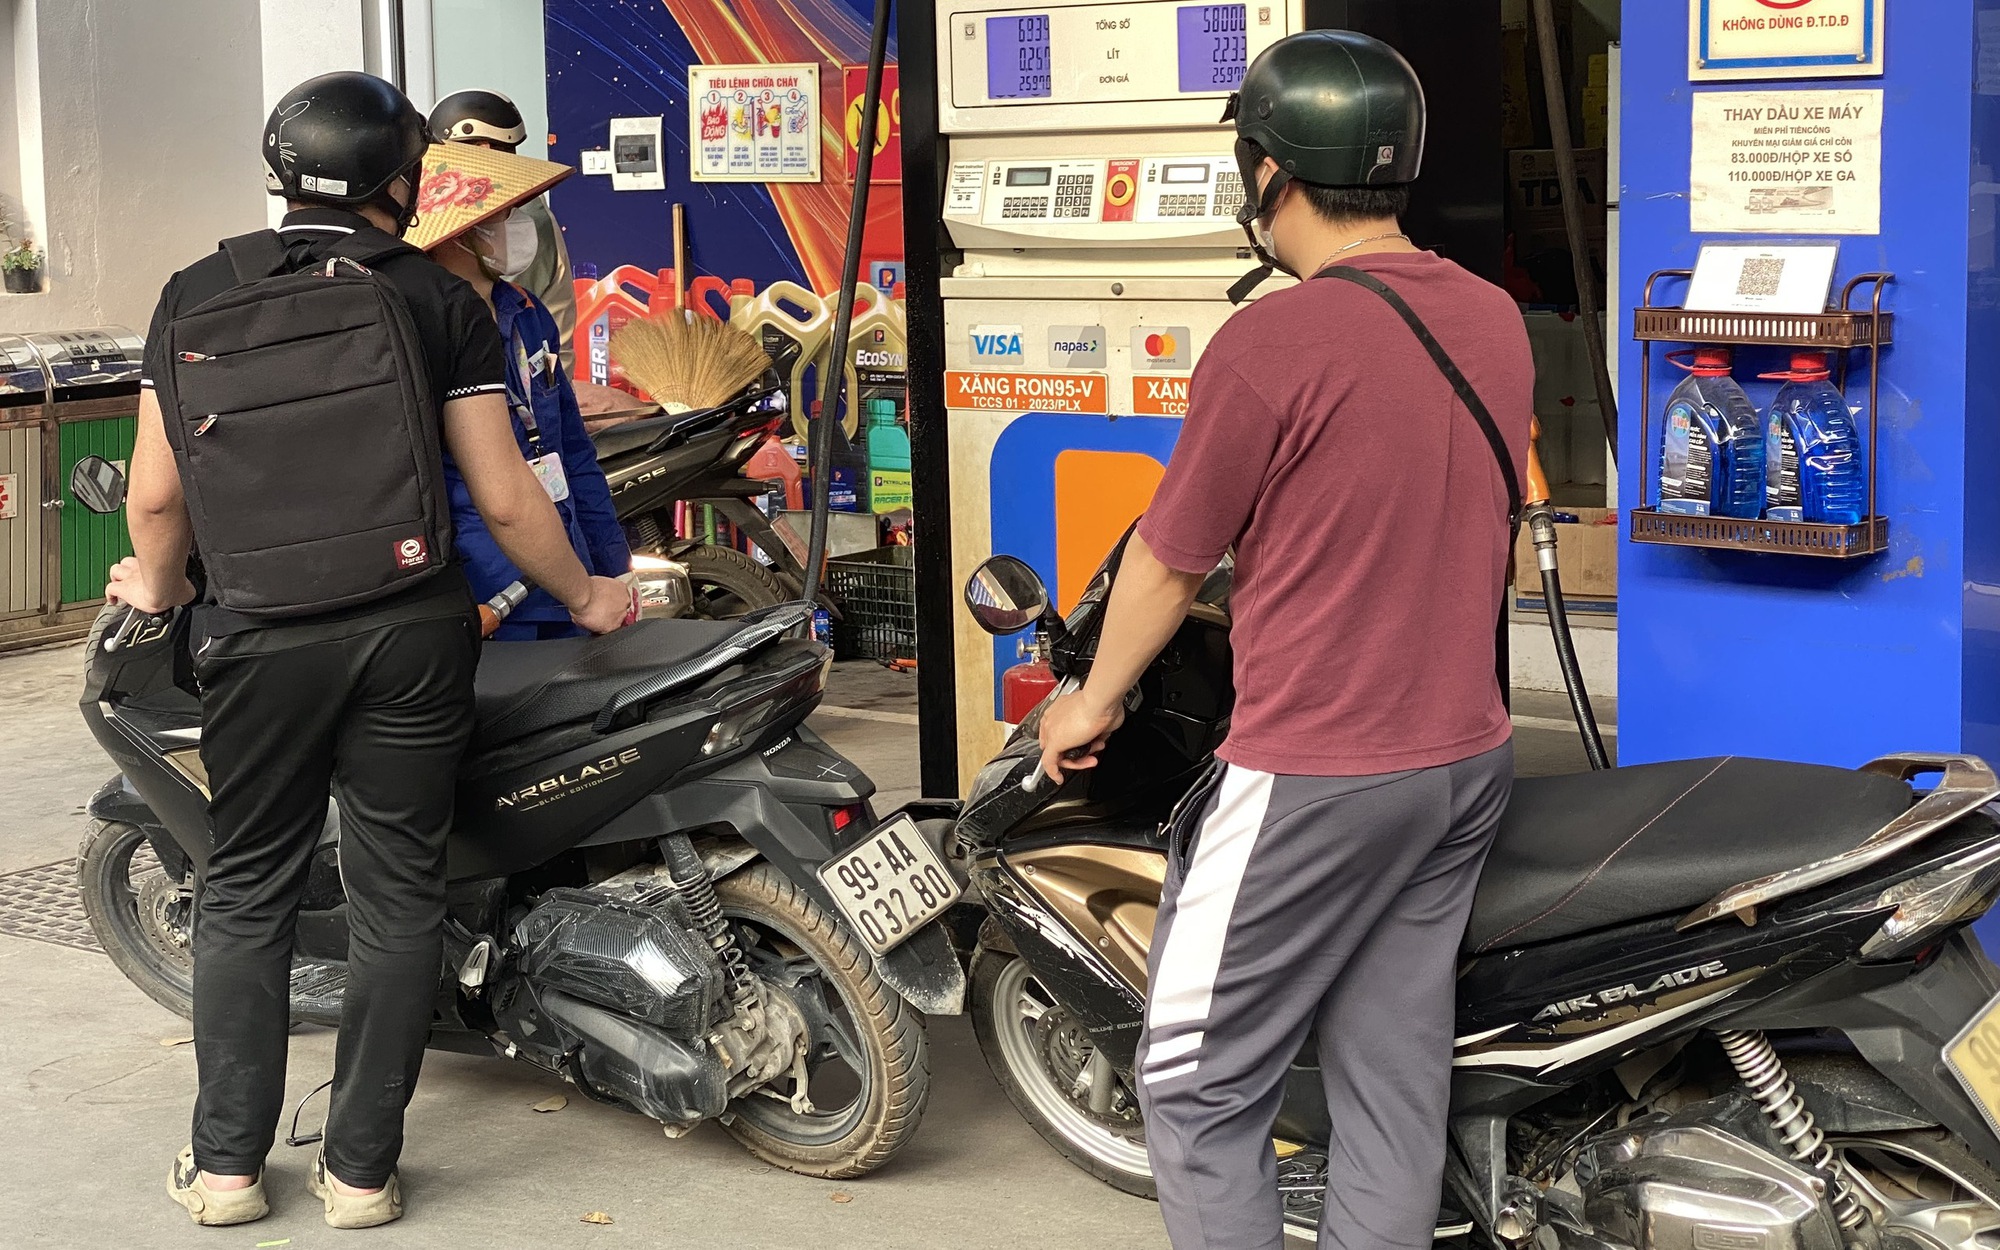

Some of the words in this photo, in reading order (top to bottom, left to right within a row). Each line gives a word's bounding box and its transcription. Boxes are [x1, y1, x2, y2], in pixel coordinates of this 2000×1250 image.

[1119, 18, 1131, 29] SỐ
[1722, 16, 1765, 31] KHÔNG
[1769, 14, 1803, 29] DÙNG
[1806, 15, 1849, 28] Đ.T.D.Đ
[1107, 48, 1120, 59] LÍT
[709, 77, 727, 88] TIÊU
[729, 77, 750, 90] LỆNH
[752, 76, 774, 88] CHỮA
[776, 76, 798, 88] CHÁY
[1116, 73, 1130, 82] GIÁ
[738, 93, 744, 101] 2
[765, 92, 770, 101] 3
[791, 92, 797, 100] 4
[1723, 108, 1763, 121] THAY
[1767, 104, 1799, 120] DẦU
[1803, 107, 1824, 120] XE
[1829, 103, 1863, 119] MÁY
[1766, 139, 1780, 148] MẠI
[1804, 137, 1818, 146] GIÁ
[1731, 150, 1810, 165] 83.000Đ/HỘP
[1813, 152, 1830, 163] XE
[1834, 149, 1853, 162] SỐ
[1728, 169, 1812, 183] 110.000Đ/HỘP
[1815, 170, 1833, 181] XE
[1836, 170, 1856, 181] GA
[972, 334, 1022, 355] VISA
[1054, 341, 1089, 354] napas
[959, 374, 1010, 395] XĂNG
[1016, 378, 1093, 397] RON95-V
[1147, 378, 1187, 399] XĂN
[972, 396, 1003, 409] TCCS
[1006, 398, 1018, 408] 01
[1029, 398, 1081, 411] 2023/PLX
[1160, 402, 1190, 414] TCC
[610, 466, 667, 496] LADE
[763, 737, 792, 757] HONDA
[539, 792, 566, 806] BLACK
[570, 779, 604, 794] EDITION
[837, 830, 918, 900] 99-AA
[859, 864, 951, 945] 032.80
[1532, 994, 1598, 1021] AIR
[1597, 960, 1728, 1004] BLADE
